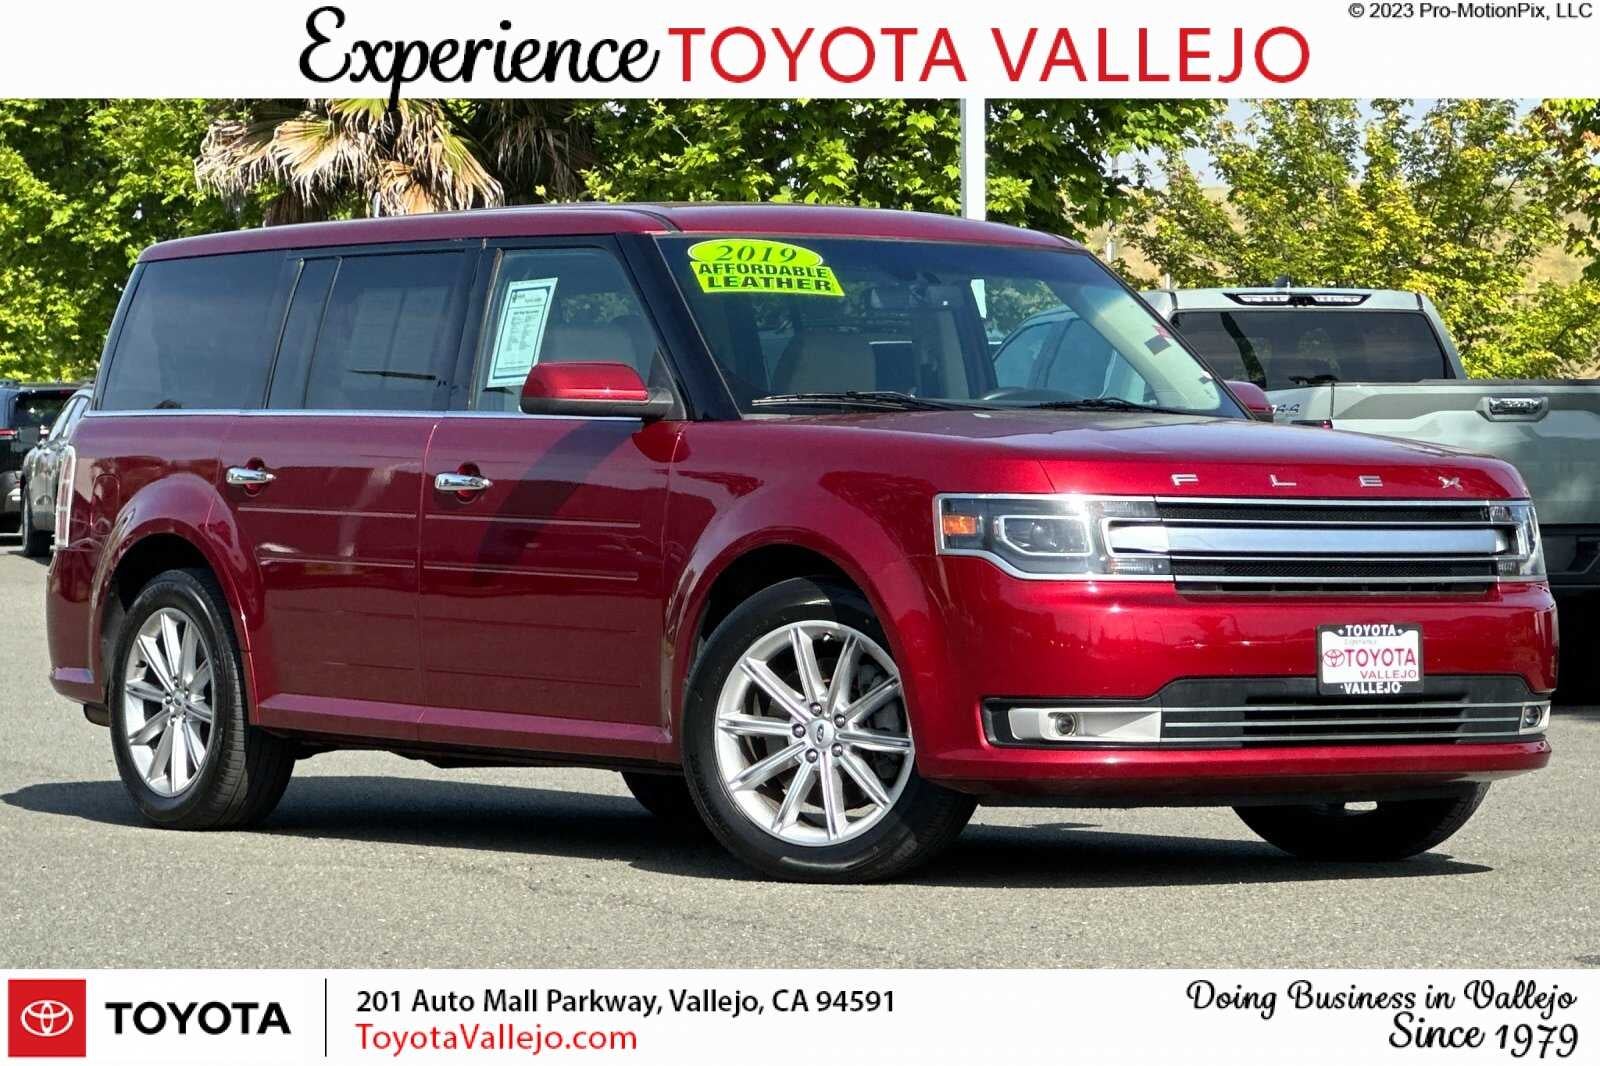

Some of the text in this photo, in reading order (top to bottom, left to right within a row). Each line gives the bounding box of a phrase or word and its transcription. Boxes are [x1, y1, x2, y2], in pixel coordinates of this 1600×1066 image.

[716, 245, 798, 263] 2019
[700, 263, 827, 279] AFFORDABLE
[708, 276, 832, 291] LEATHER
[1345, 624, 1397, 636] TOYOTA
[1344, 648, 1416, 667] TOYOTA
[1360, 669, 1417, 680] VALLEJO
[1343, 681, 1401, 694] VALLEJO
